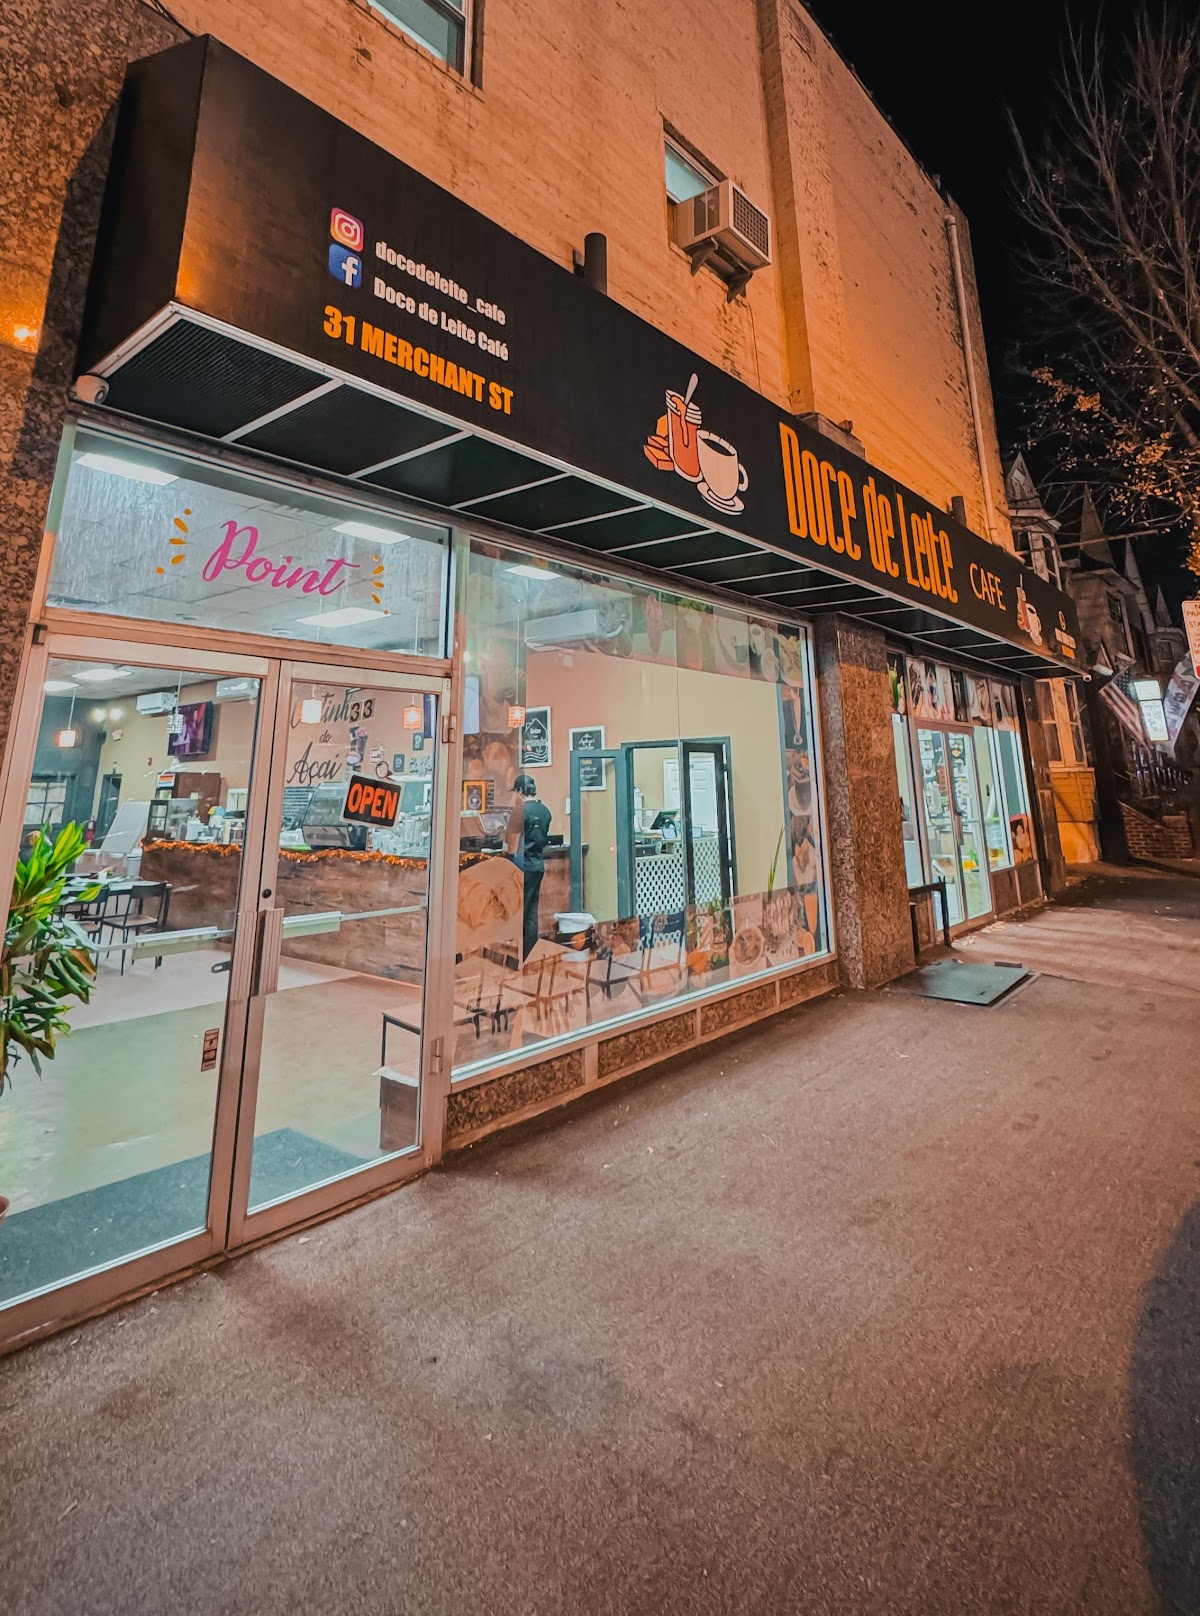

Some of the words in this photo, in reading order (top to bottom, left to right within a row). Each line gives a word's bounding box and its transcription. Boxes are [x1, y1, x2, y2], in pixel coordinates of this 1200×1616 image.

[373, 276, 416, 315] Doce
[418, 302, 438, 326] de
[440, 311, 476, 345] Leite
[477, 331, 509, 362] Café
[375, 241, 506, 325] docedeleite_cafe
[323, 305, 356, 346] 31
[360, 321, 486, 403] MERCHANT
[488, 381, 514, 415] ST
[202, 520, 360, 596] Point
[778, 421, 862, 561] Doce
[862, 476, 900, 578] de
[897, 493, 958, 605] Leite
[969, 562, 1007, 611] CAFE
[351, 701, 373, 722] 33
[347, 782, 399, 820] OPEN
